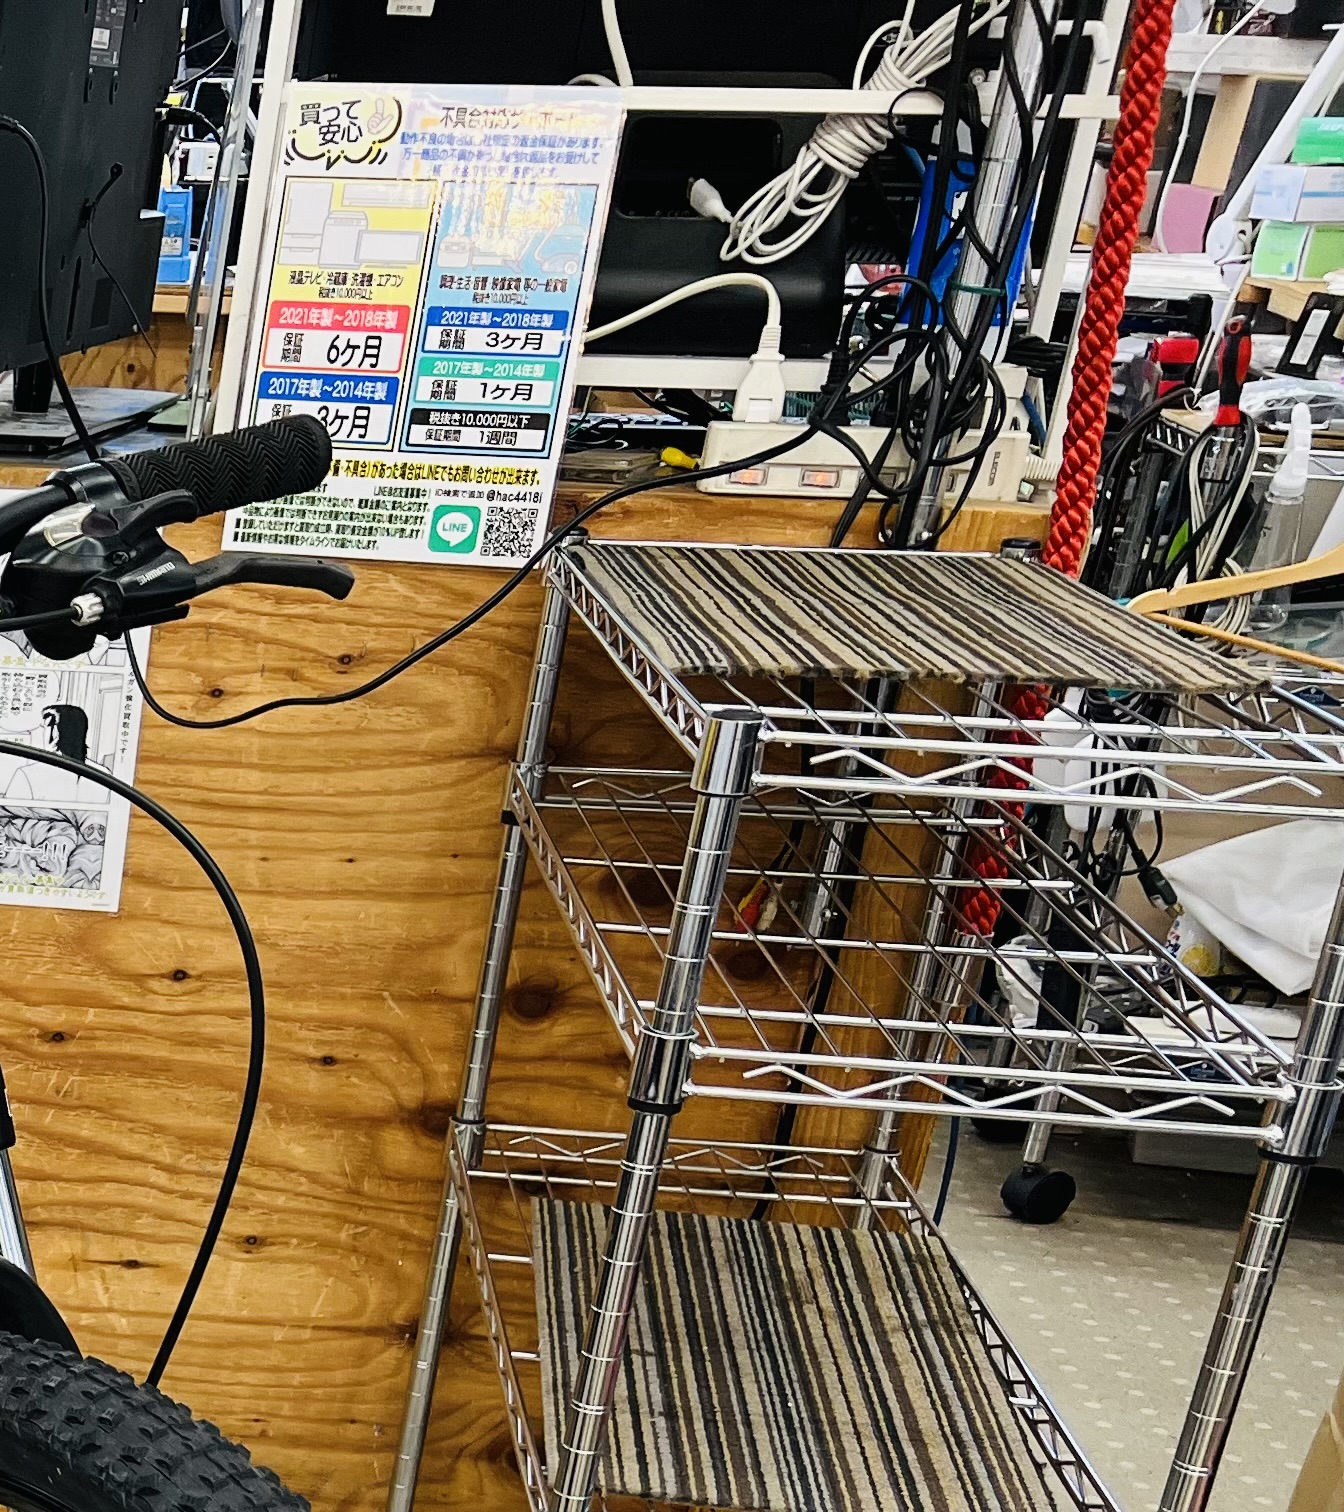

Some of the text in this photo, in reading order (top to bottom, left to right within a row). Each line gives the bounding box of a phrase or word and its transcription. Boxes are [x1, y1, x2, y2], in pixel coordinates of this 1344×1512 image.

[300, 99, 361, 126] 買って
[318, 121, 363, 147] 安心
[441, 522, 468, 533] LINE
